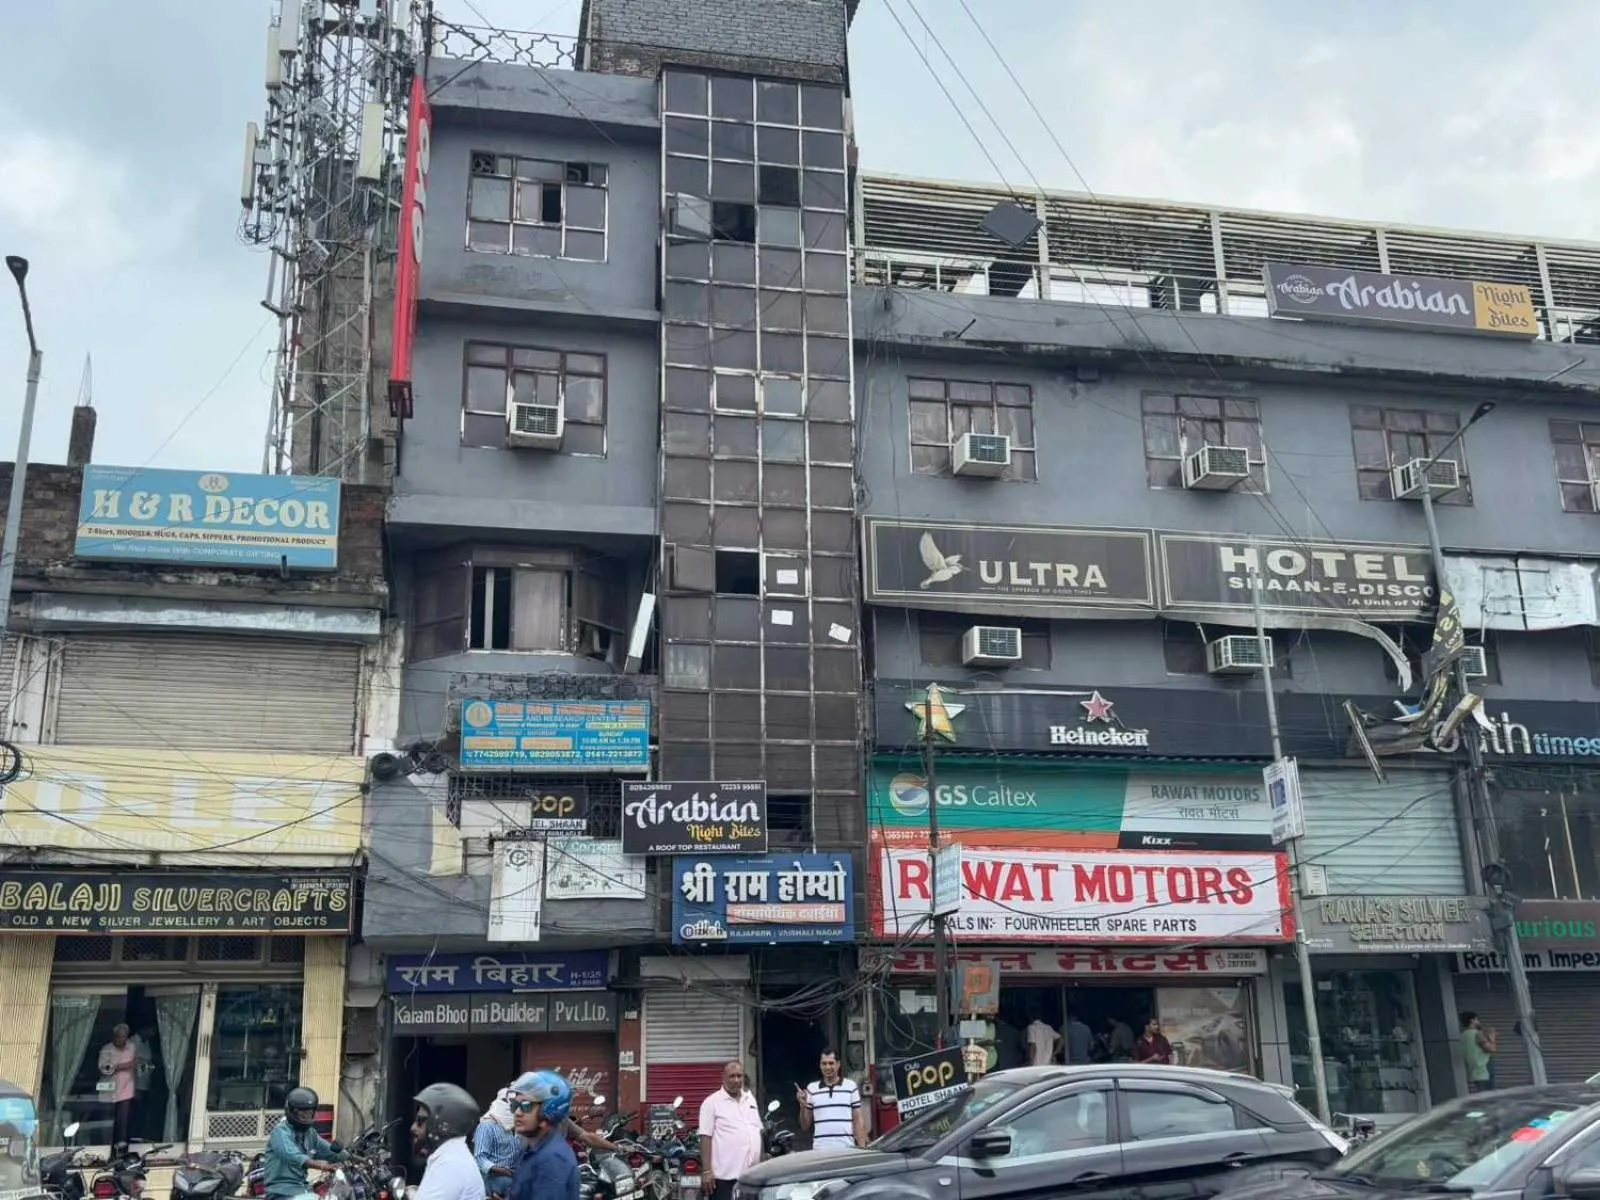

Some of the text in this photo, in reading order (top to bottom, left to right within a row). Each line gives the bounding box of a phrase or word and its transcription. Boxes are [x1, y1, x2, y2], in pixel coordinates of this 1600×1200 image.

[1277, 283, 1324, 297] Arabian
[1325, 275, 1470, 316] Arabian
[1475, 284, 1527, 308] Night
[1487, 307, 1529, 328] Bites
[92, 489, 332, 530] H & R DECOR
[979, 560, 1108, 588] ULTRA
[1219, 547, 1426, 582] HOTEL
[1049, 726, 1150, 747] Heineken
[1533, 731, 1600, 756] times
[935, 783, 1039, 808] GS Caltex
[1150, 784, 1260, 802] RAWAT MOTORS
[625, 792, 761, 829] Arabian
[1176, 806, 1205, 820] रावत
[686, 822, 761, 843] Night Bites
[1141, 835, 1173, 846] Kixx
[694, 843, 742, 851] RESTAURANT
[681, 862, 717, 902] श्री
[723, 871, 770, 902] राम
[776, 860, 848, 902] होम्यो
[897, 858, 1060, 903] RWAT
[1071, 863, 1254, 906] MOTORS
[0, 881, 348, 912] BALAJI SILVERCRAFTS
[12, 915, 328, 926] OLD & NEW SILVER JEWELLERY & ART OBJECTS
[1320, 898, 1472, 924] RANA'S SILVER
[729, 930, 772, 938] RAJAPARK
[778, 929, 815, 938] VAISHALI
[816, 928, 844, 937] NAGAR
[1004, 916, 1100, 932] FOURWHEELER
[1107, 918, 1148, 932] SPARE
[1153, 919, 1198, 932] PARTS
[1349, 923, 1446, 942] SELECTION
[396, 956, 565, 987] राम बिहार
[394, 1005, 435, 1025] Karam
[489, 1002, 545, 1024] Builder
[906, 1061, 955, 1097] pop
[901, 1093, 931, 1110] HOTEL
